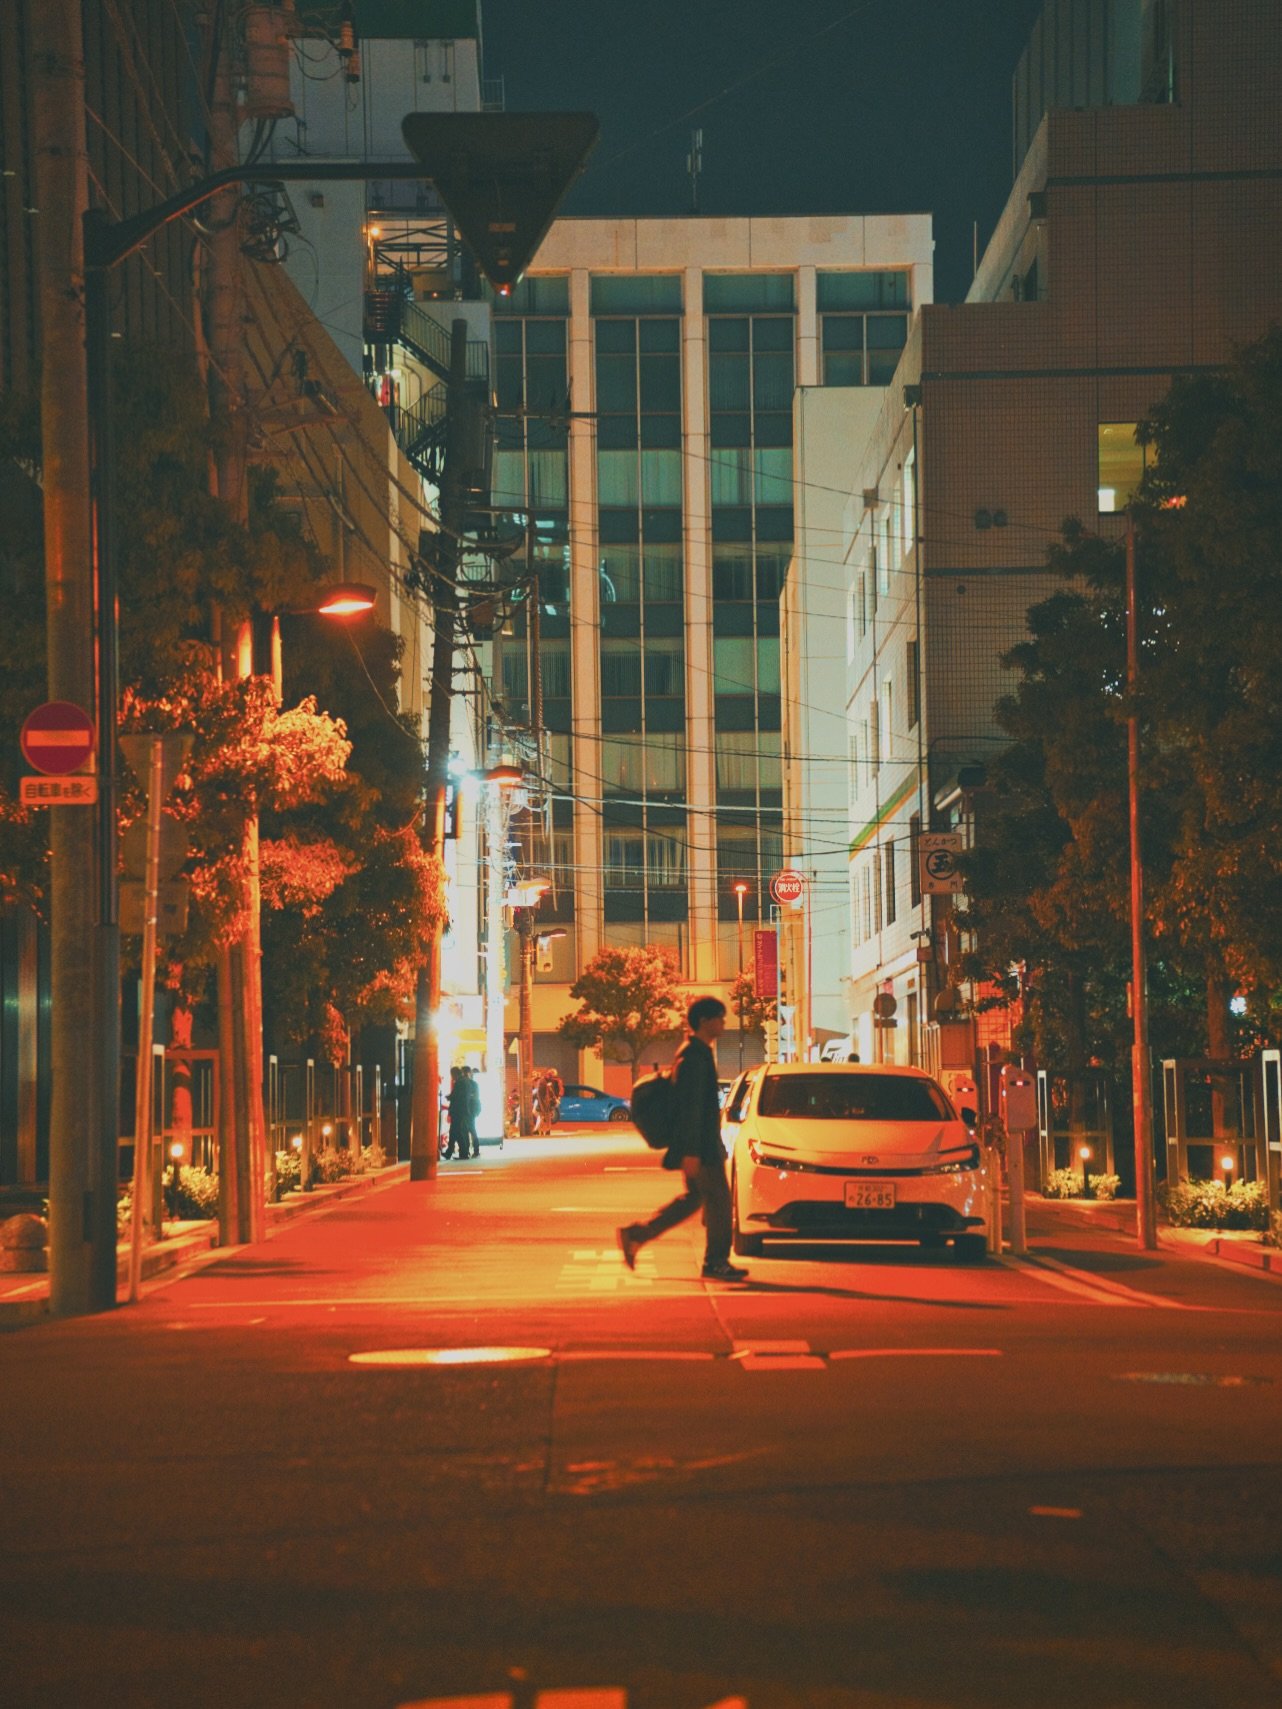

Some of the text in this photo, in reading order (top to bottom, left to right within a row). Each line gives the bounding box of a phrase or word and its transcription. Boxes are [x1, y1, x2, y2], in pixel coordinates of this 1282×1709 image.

[25, 782, 91, 799] 自転車を除く
[925, 838, 957, 847] とんかつ
[778, 883, 801, 893] 消火栓
